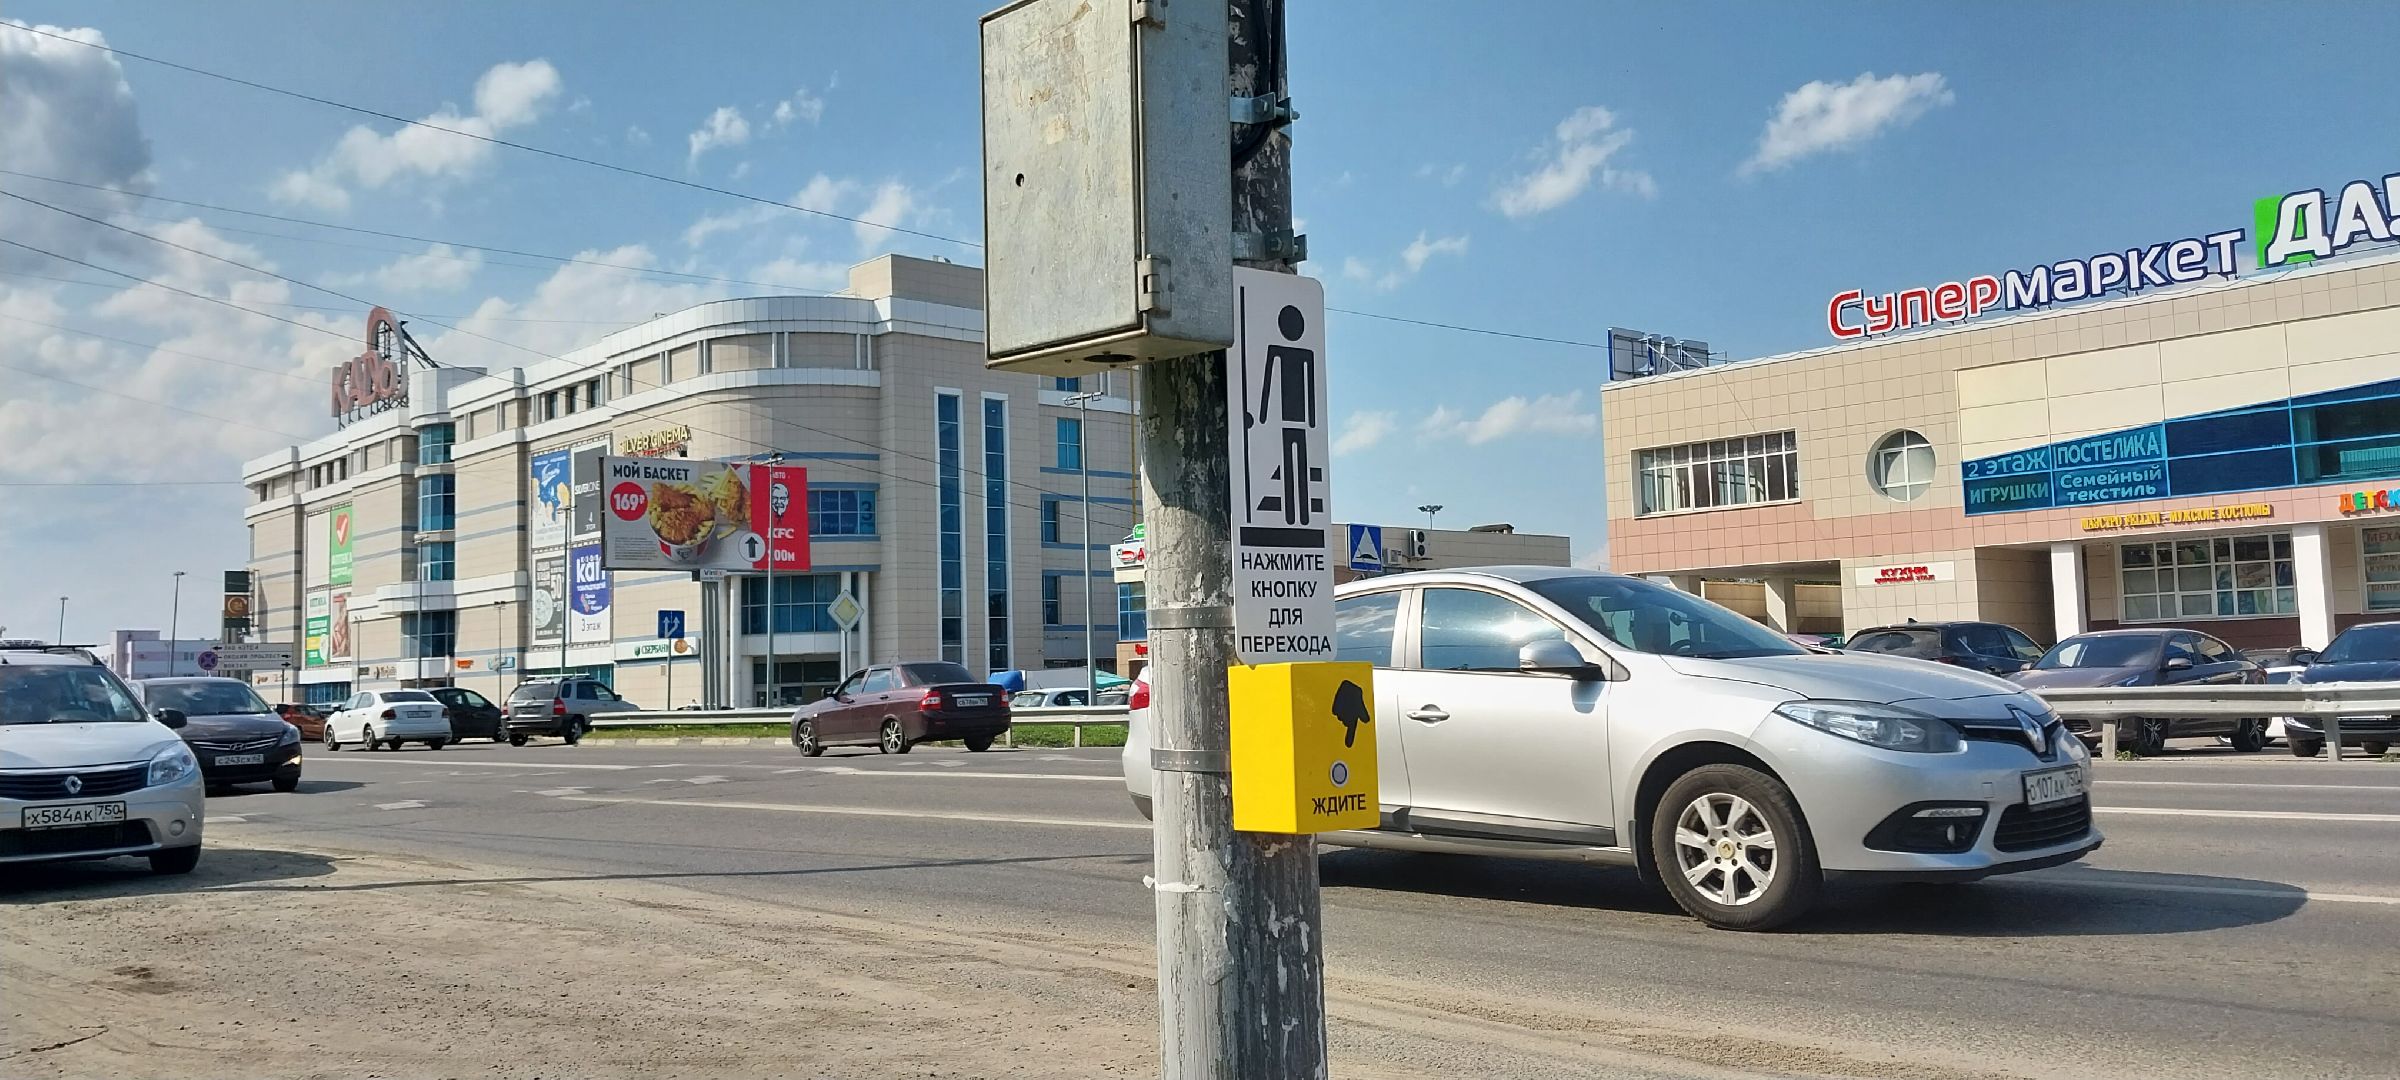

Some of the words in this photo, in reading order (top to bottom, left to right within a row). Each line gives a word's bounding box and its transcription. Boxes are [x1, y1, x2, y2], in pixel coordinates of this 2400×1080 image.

[1827, 227, 2247, 340] Супермаркет
[650, 426, 690, 448] CINEMA
[2057, 433, 2161, 466] ПОСТЕЛИКА
[613, 461, 641, 478] МОЙ
[643, 466, 690, 481] БАСКЕТ
[1967, 461, 1980, 478] 2
[2060, 464, 2162, 489] Семейный
[1970, 481, 2049, 505] ИГРУШКИ
[2066, 484, 2157, 503] текстиль
[2169, 506, 2216, 524] МУЖСКИЕ
[2217, 503, 2272, 521] КОСТЮМЫ
[1241, 552, 1325, 572] НАЖМИТЕ
[1251, 580, 1318, 598] КНОПКУ
[1268, 608, 1303, 628] ДЛЯ
[1241, 635, 1332, 656] ПЕРЕХОДА
[1312, 793, 1367, 817] ЖДИТЕ
[31, 808, 93, 825] Х584АК
